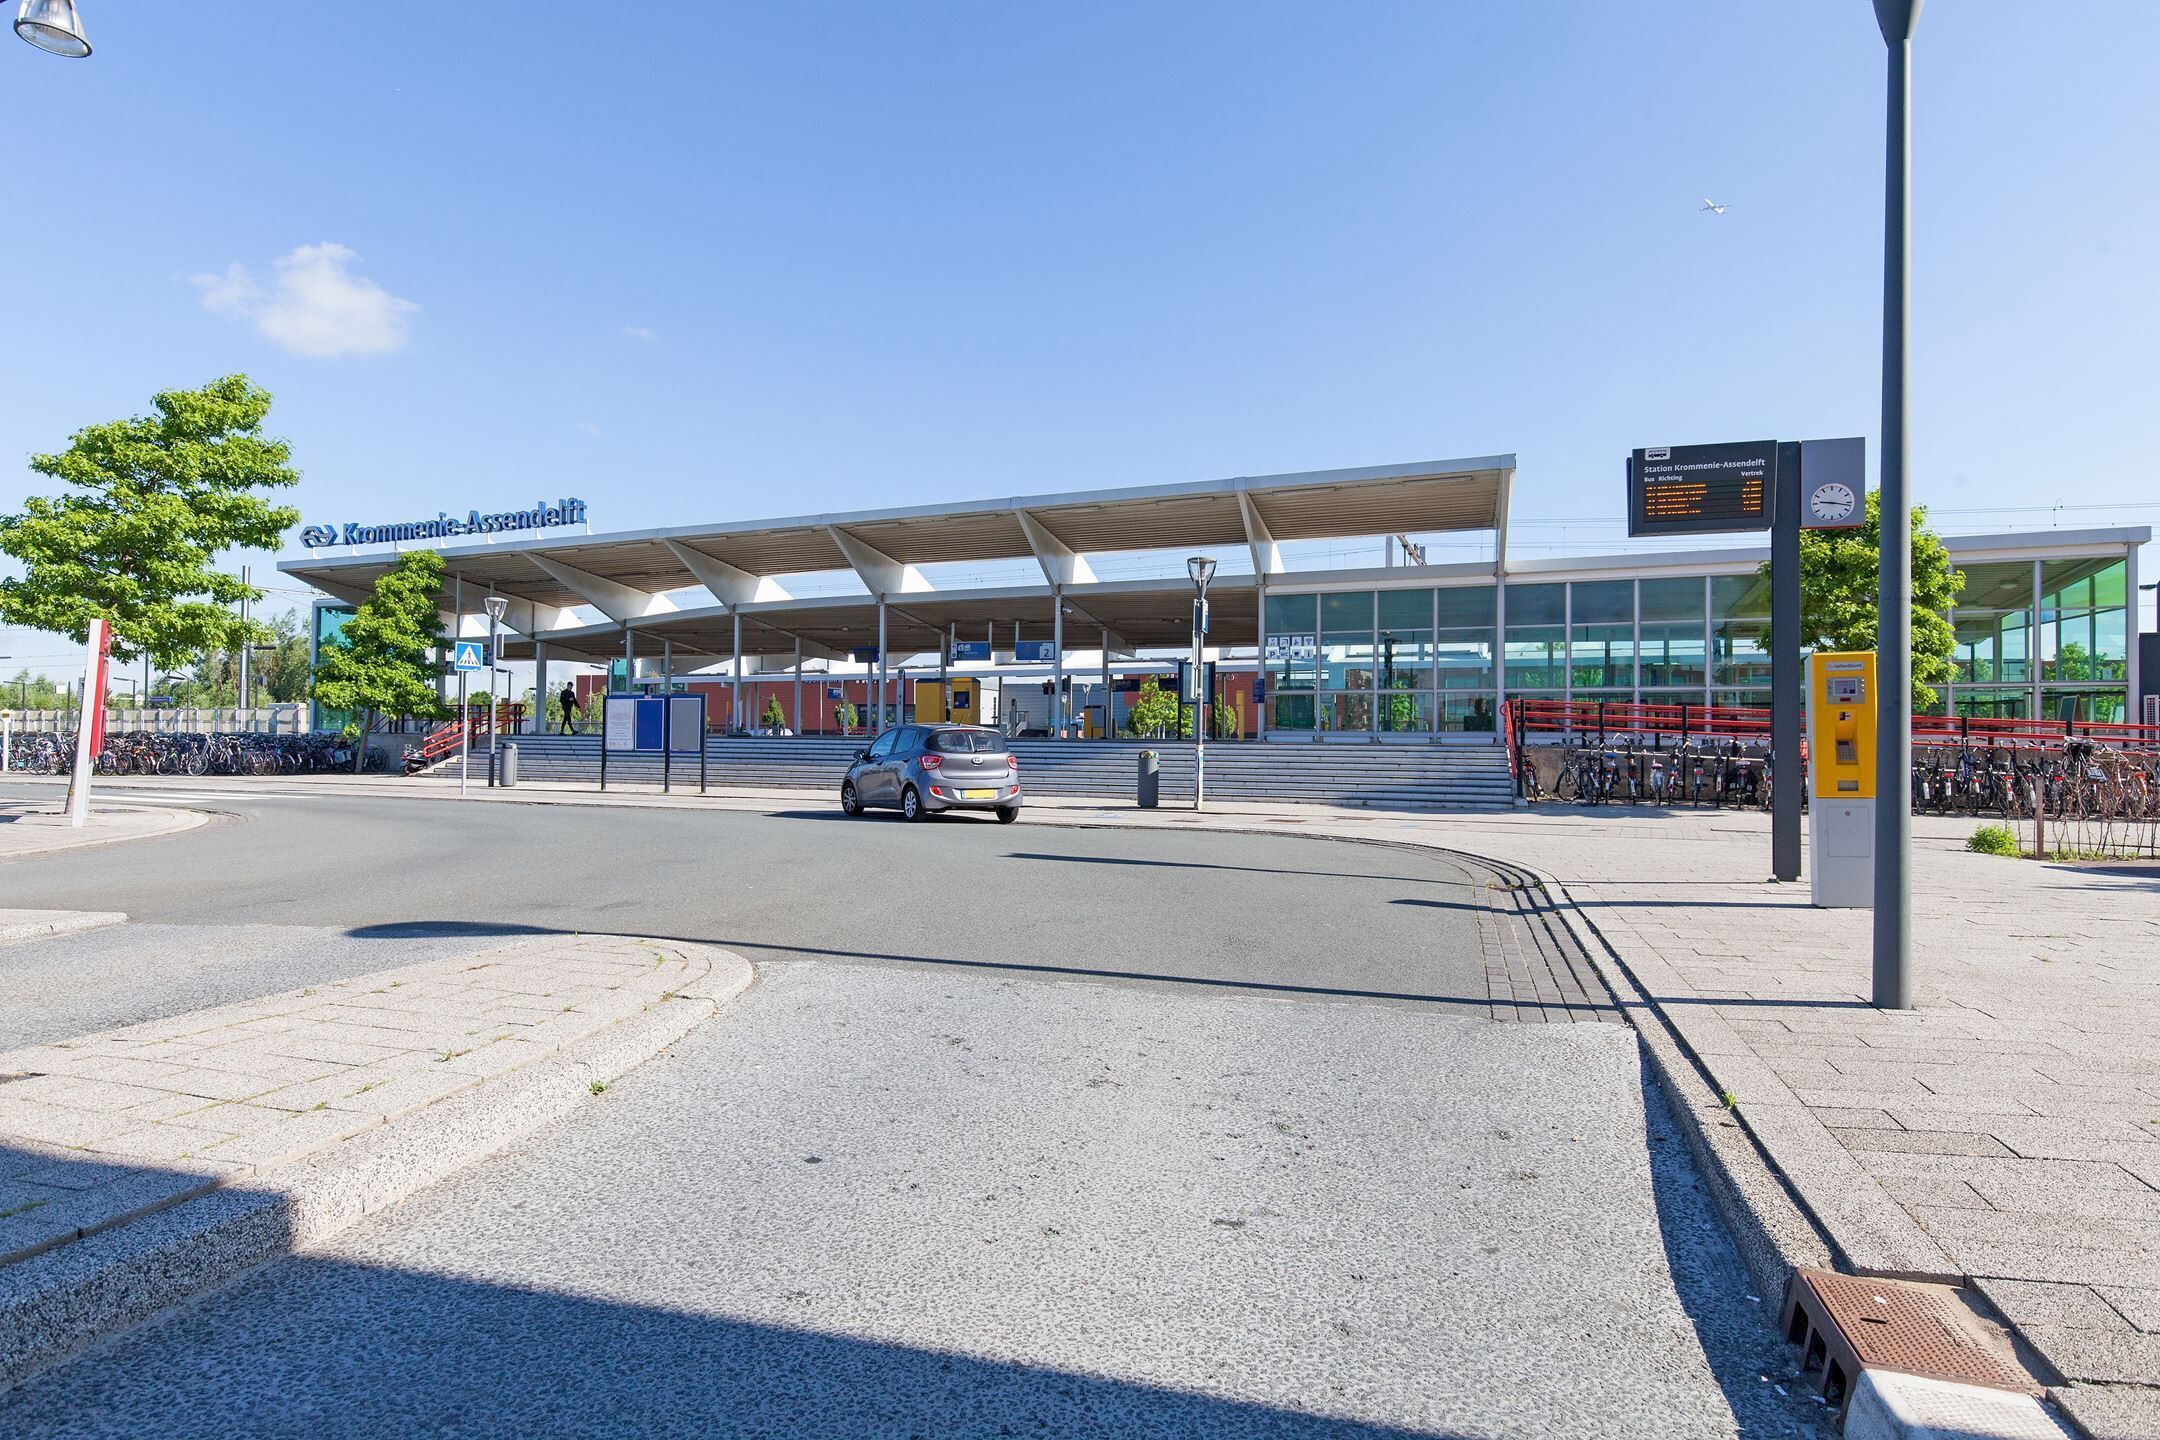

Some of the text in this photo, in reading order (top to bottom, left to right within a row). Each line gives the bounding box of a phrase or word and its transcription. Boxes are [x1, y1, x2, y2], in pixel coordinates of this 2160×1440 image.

[1644, 458, 1765, 473] Station Krommenie-Assendelft
[342, 497, 588, 545] Krommenie-Assendelft
[1044, 648, 1050, 657] 2
